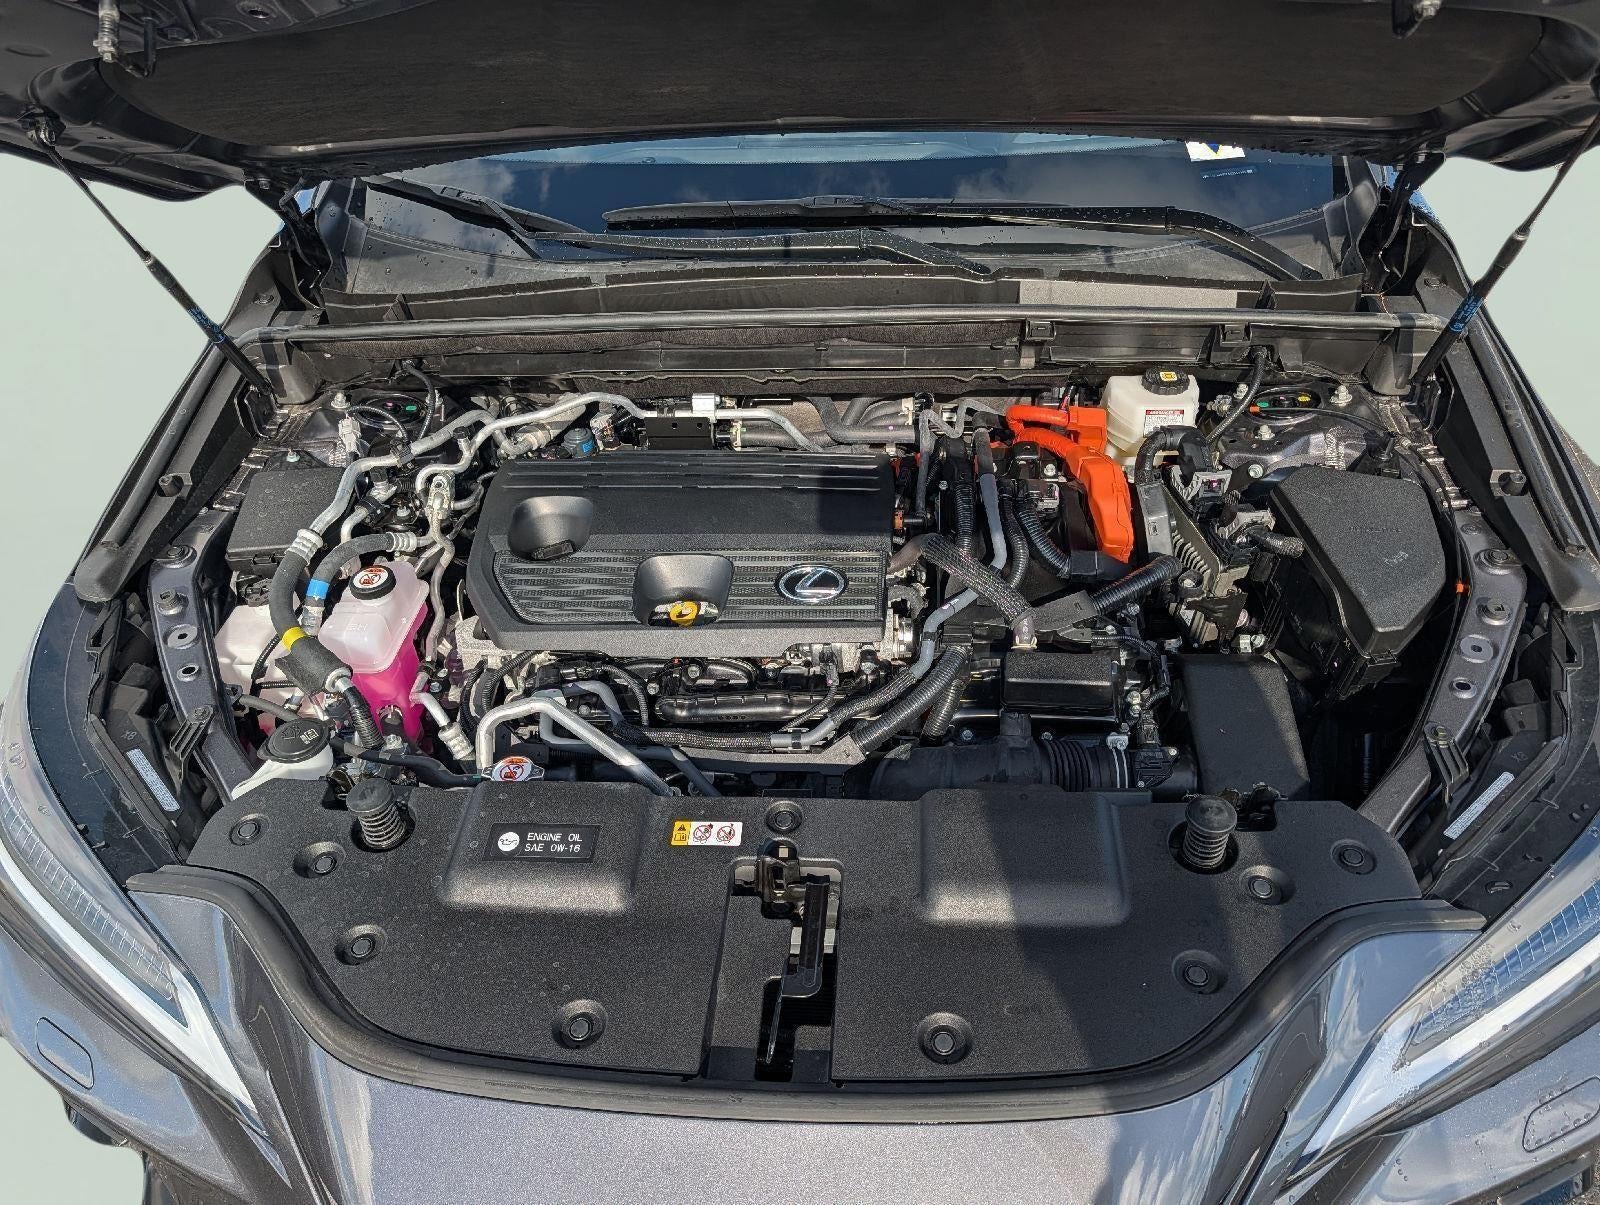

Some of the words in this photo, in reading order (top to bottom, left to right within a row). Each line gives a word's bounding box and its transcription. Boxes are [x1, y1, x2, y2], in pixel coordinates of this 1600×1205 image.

[527, 833, 562, 842] ENGINE
[568, 833, 582, 842] OIL
[524, 844, 544, 852] SAE
[550, 844, 581, 853] 0W-16
